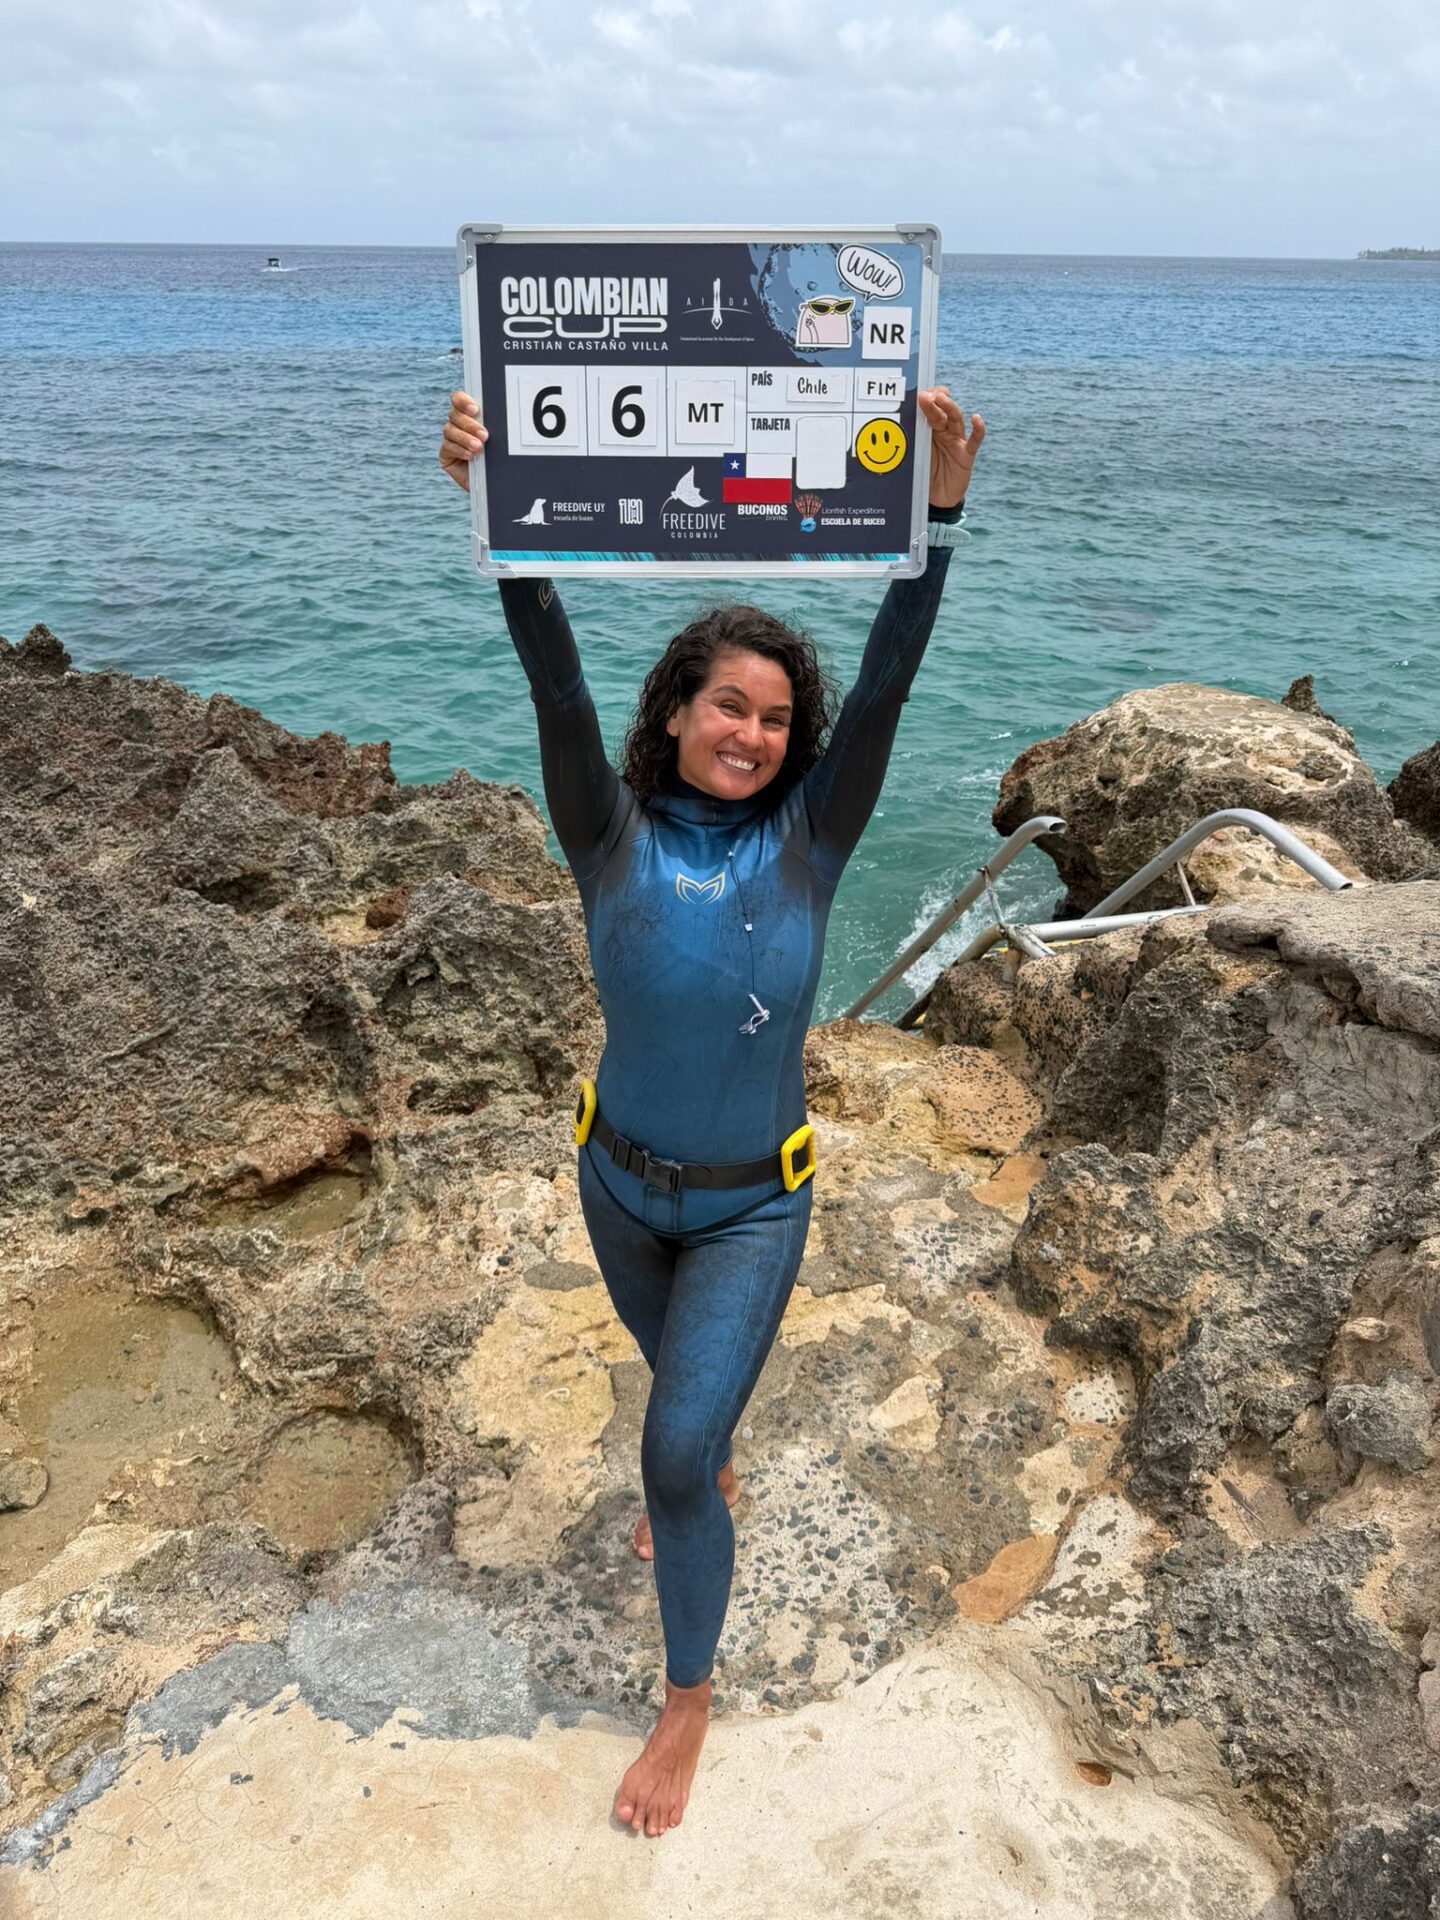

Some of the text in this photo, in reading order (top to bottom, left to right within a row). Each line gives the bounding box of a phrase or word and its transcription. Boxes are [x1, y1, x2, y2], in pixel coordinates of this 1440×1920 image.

[500, 276, 668, 316] COLOMBIAN
[503, 316, 668, 339] CUP
[870, 323, 905, 345] NR
[503, 339, 668, 351] CRISTIAN CASTAÑO VILLA
[751, 370, 773, 386] PAÍS
[797, 377, 828, 395] Chile
[867, 381, 897, 396] FIM
[532, 385, 724, 439] 6 6 MT
[751, 418, 791, 431] TARJETA
[552, 502, 593, 512] FREEDIVE
[737, 504, 788, 516] BUCONOS
[662, 513, 726, 530] FREEDIVE
[821, 518, 886, 526] ESCUELA DE BUCEO
